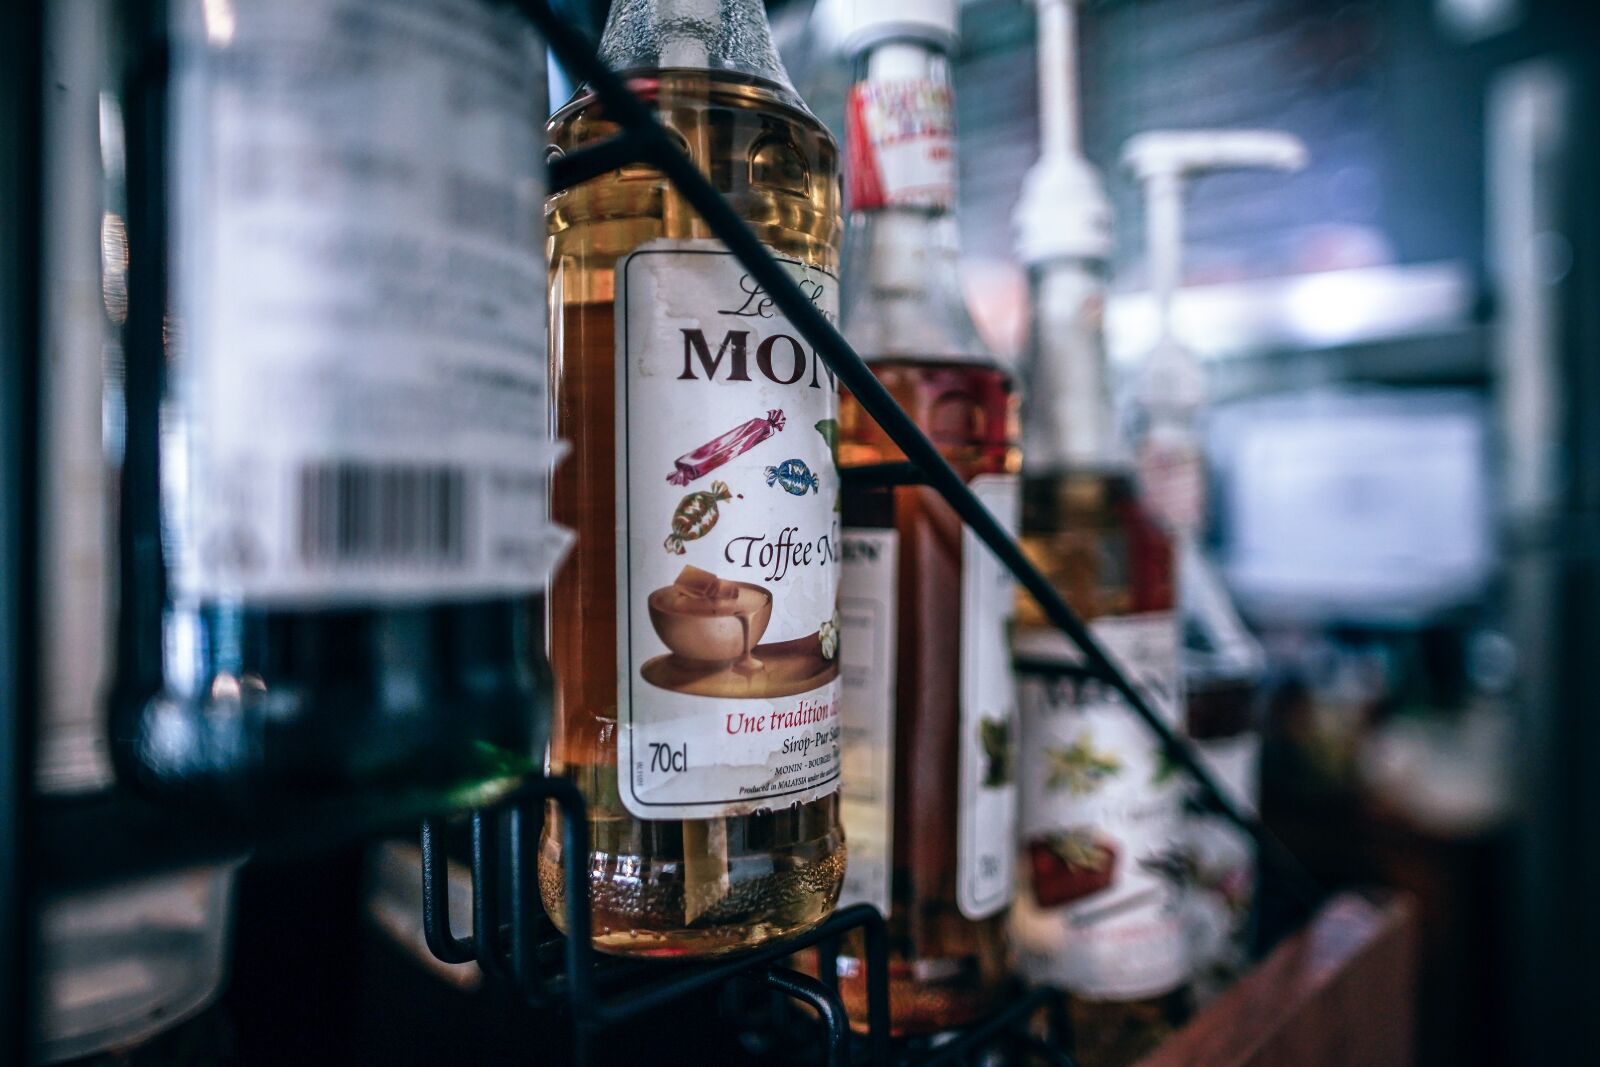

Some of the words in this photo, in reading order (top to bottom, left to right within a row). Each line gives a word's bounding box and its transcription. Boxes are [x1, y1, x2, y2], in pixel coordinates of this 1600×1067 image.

[718, 273, 775, 318] Le
[724, 527, 813, 581] Toffee
[726, 712, 765, 735] Une
[770, 700, 829, 730] tradition
[649, 742, 688, 772] 70cl
[775, 763, 802, 775] MONIN
[739, 782, 770, 794] Produced
[778, 777, 806, 789] MALAYSIA
